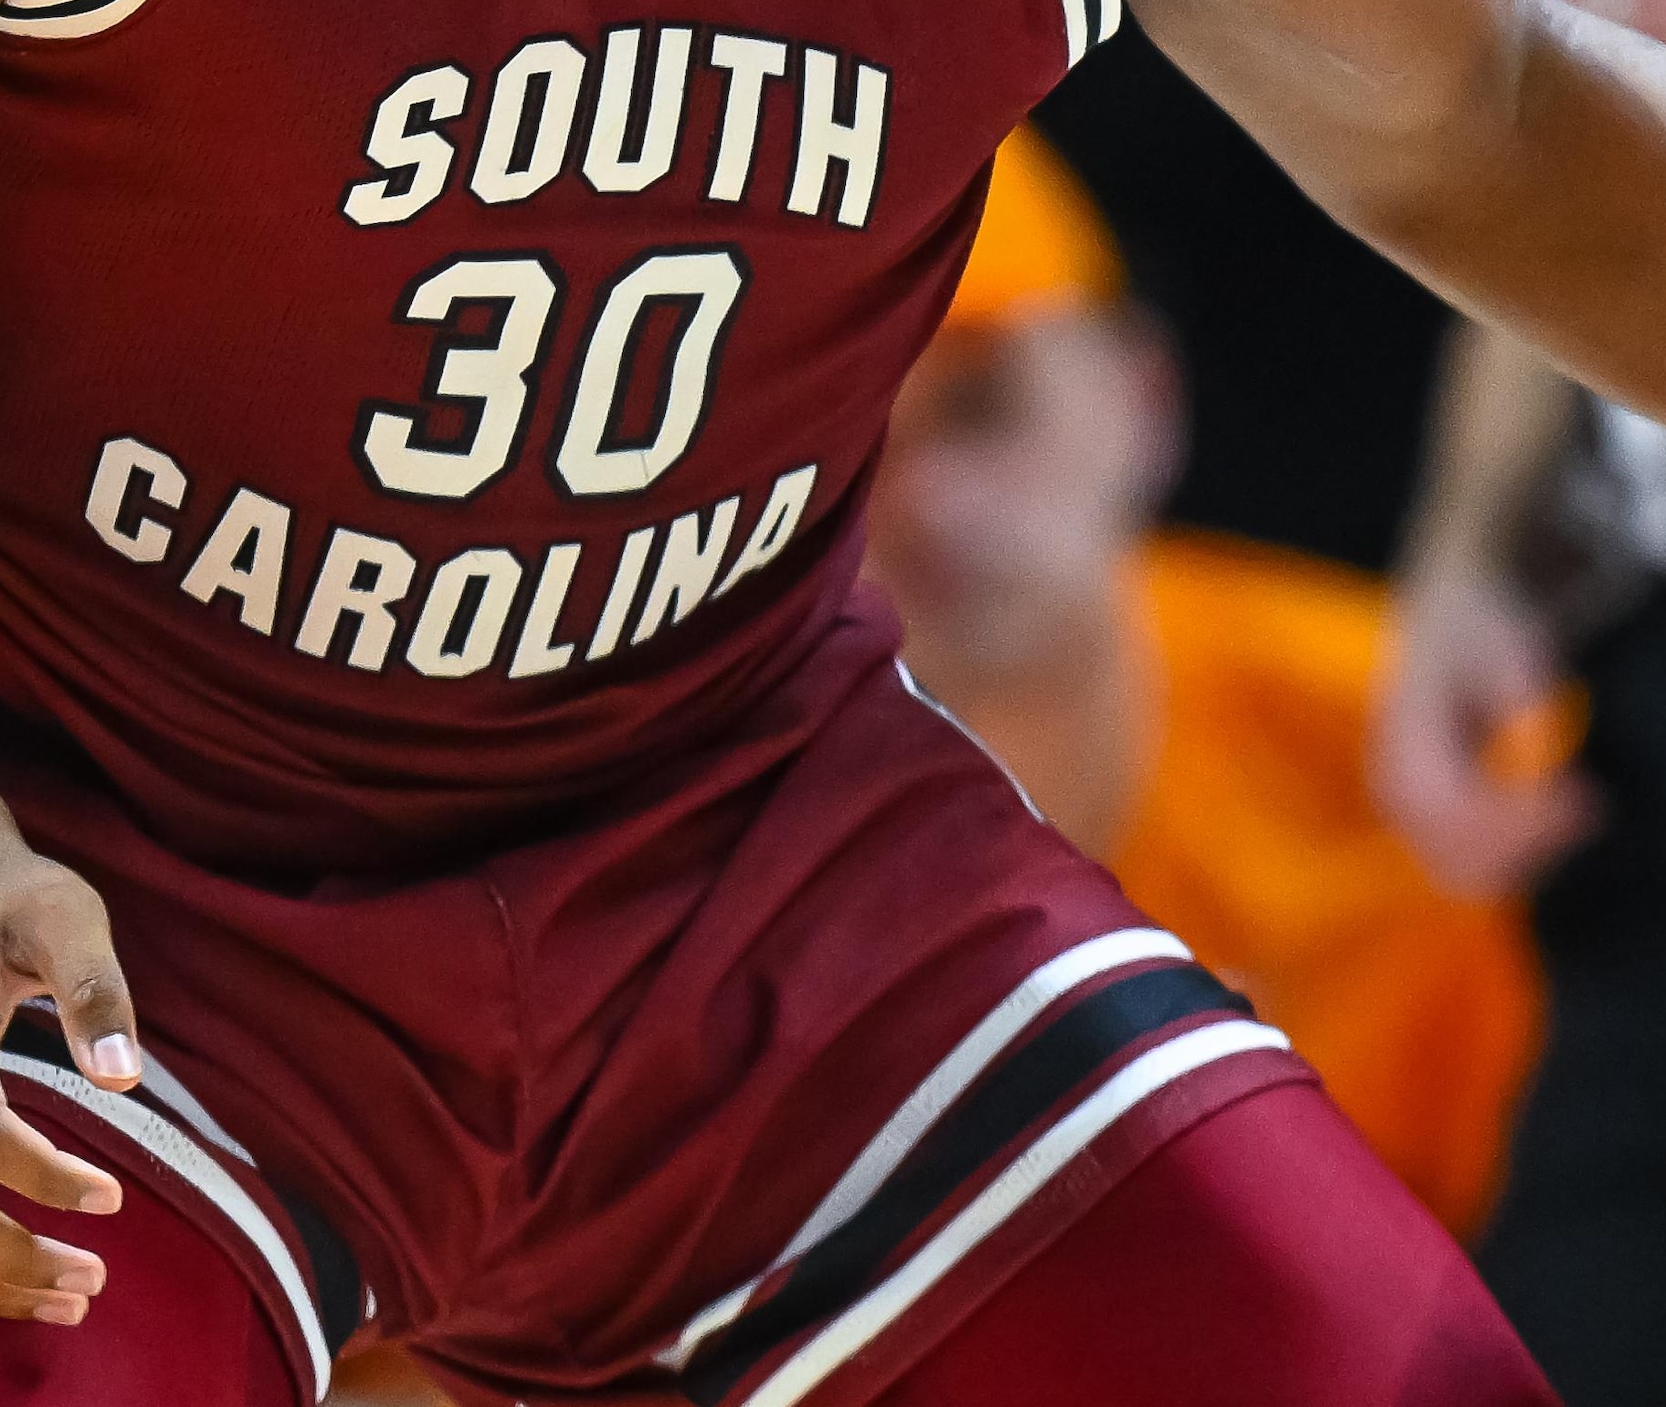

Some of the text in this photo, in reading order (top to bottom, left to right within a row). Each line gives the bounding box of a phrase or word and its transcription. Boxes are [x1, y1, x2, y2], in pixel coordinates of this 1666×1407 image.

[339, 24, 892, 231] SOUTH
[357, 246, 747, 501] 30
[82, 434, 820, 682] CAROLINA
